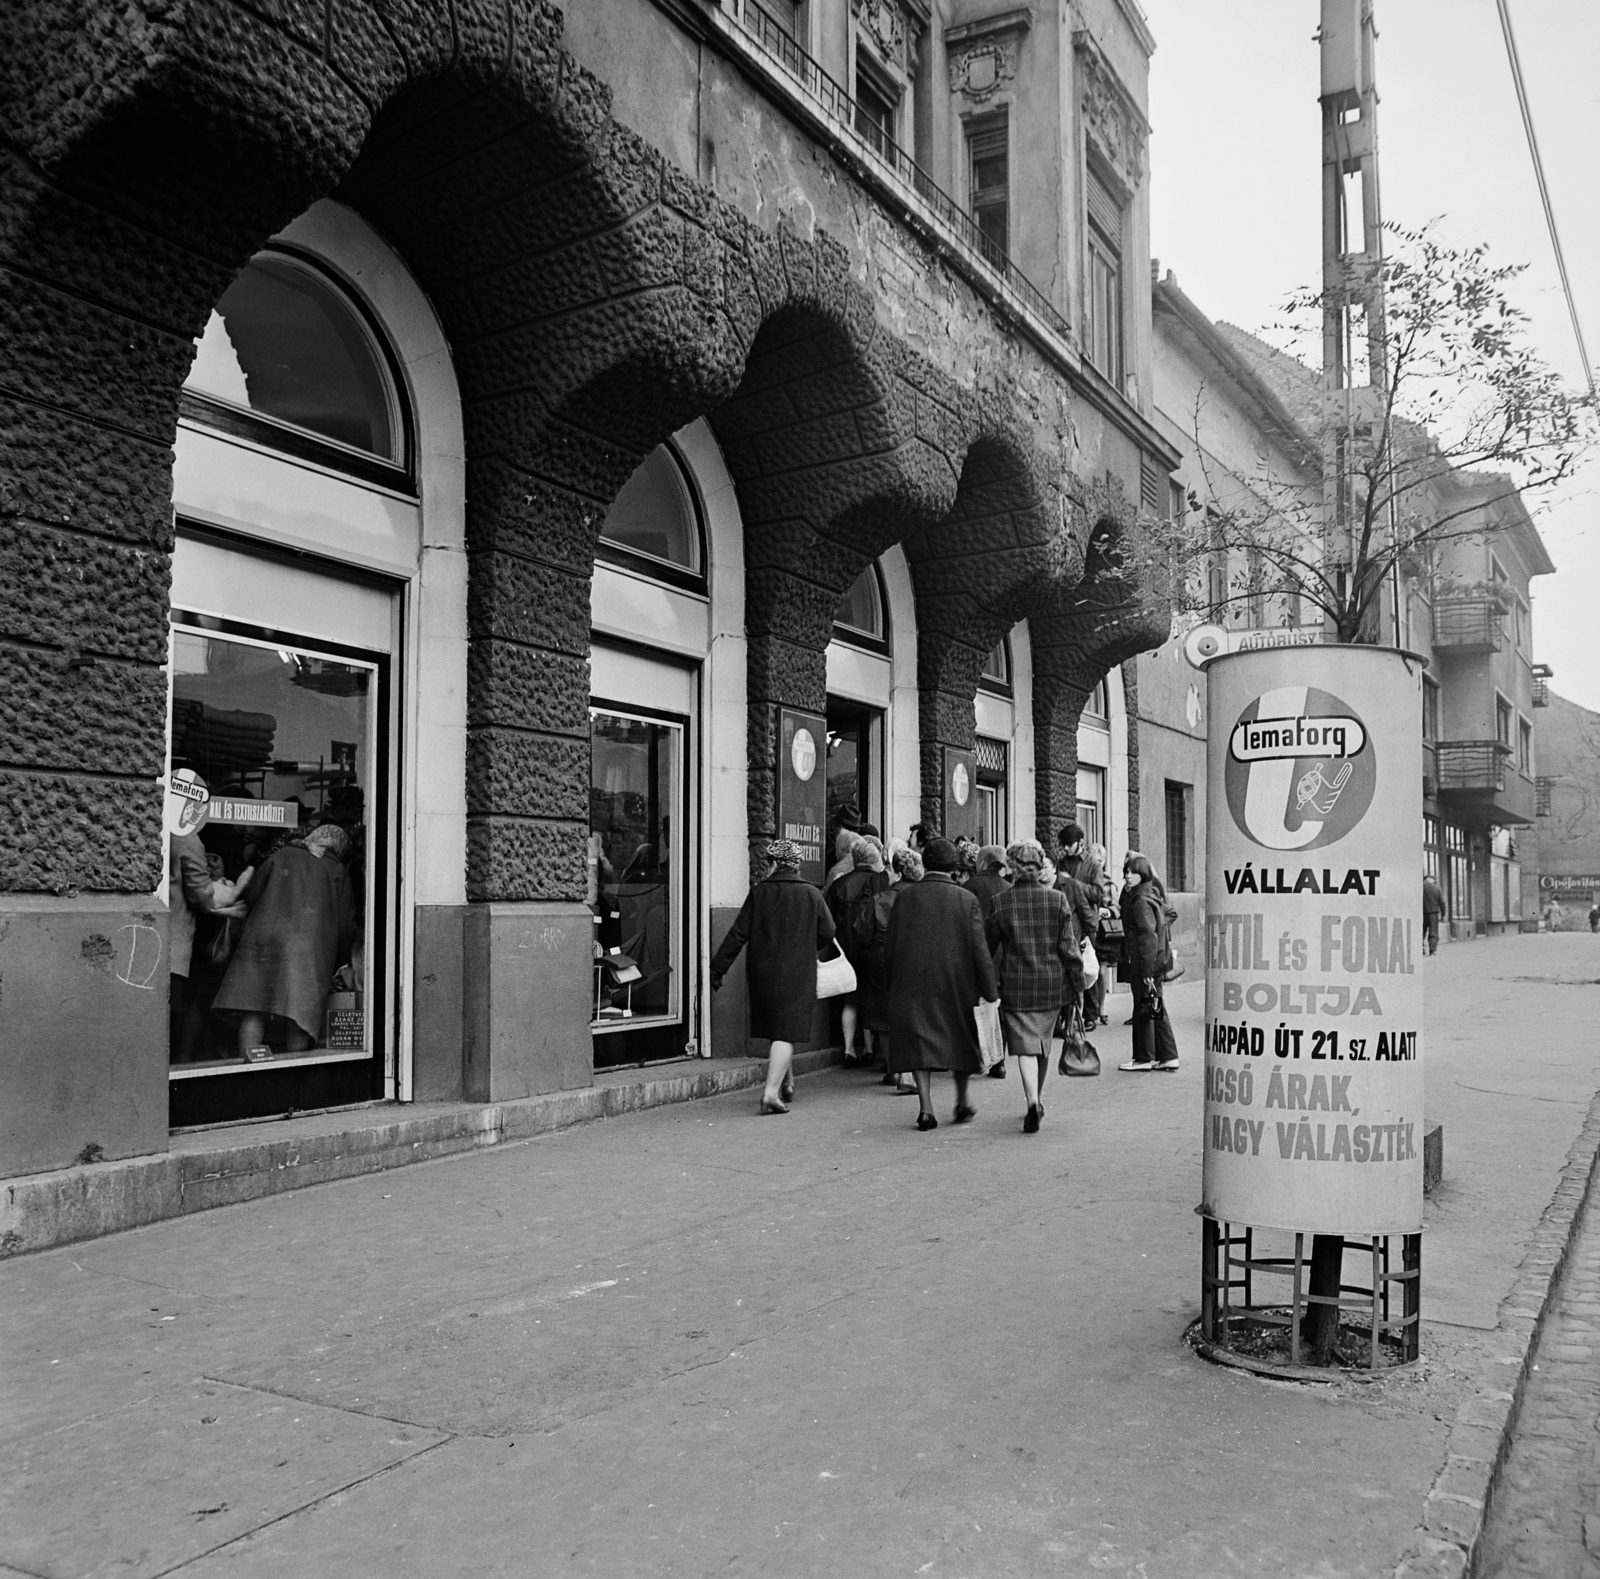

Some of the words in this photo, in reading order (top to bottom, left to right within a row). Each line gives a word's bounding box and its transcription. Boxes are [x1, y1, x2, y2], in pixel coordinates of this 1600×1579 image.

[1241, 716, 1346, 757] Temaforg
[171, 780, 204, 802] emaforg
[223, 799, 232, 820] ÉS
[1224, 862, 1380, 896] VÁLLALAT
[1320, 915, 1415, 975] FONAL
[1223, 982, 1383, 1016] BOLTJA
[1212, 1017, 1264, 1057] ÁRPÁD
[1275, 1022, 1304, 1058] ÚT
[1311, 1030, 1344, 1061] 21.
[1375, 1031, 1417, 1062] ALATT
[1206, 1063, 1254, 1106] OLCSÓ
[1265, 1065, 1360, 1116] ÁRAK,
[1212, 1114, 1265, 1157] NAGY
[1276, 1116, 1417, 1163] VÁLASZTÉK.
